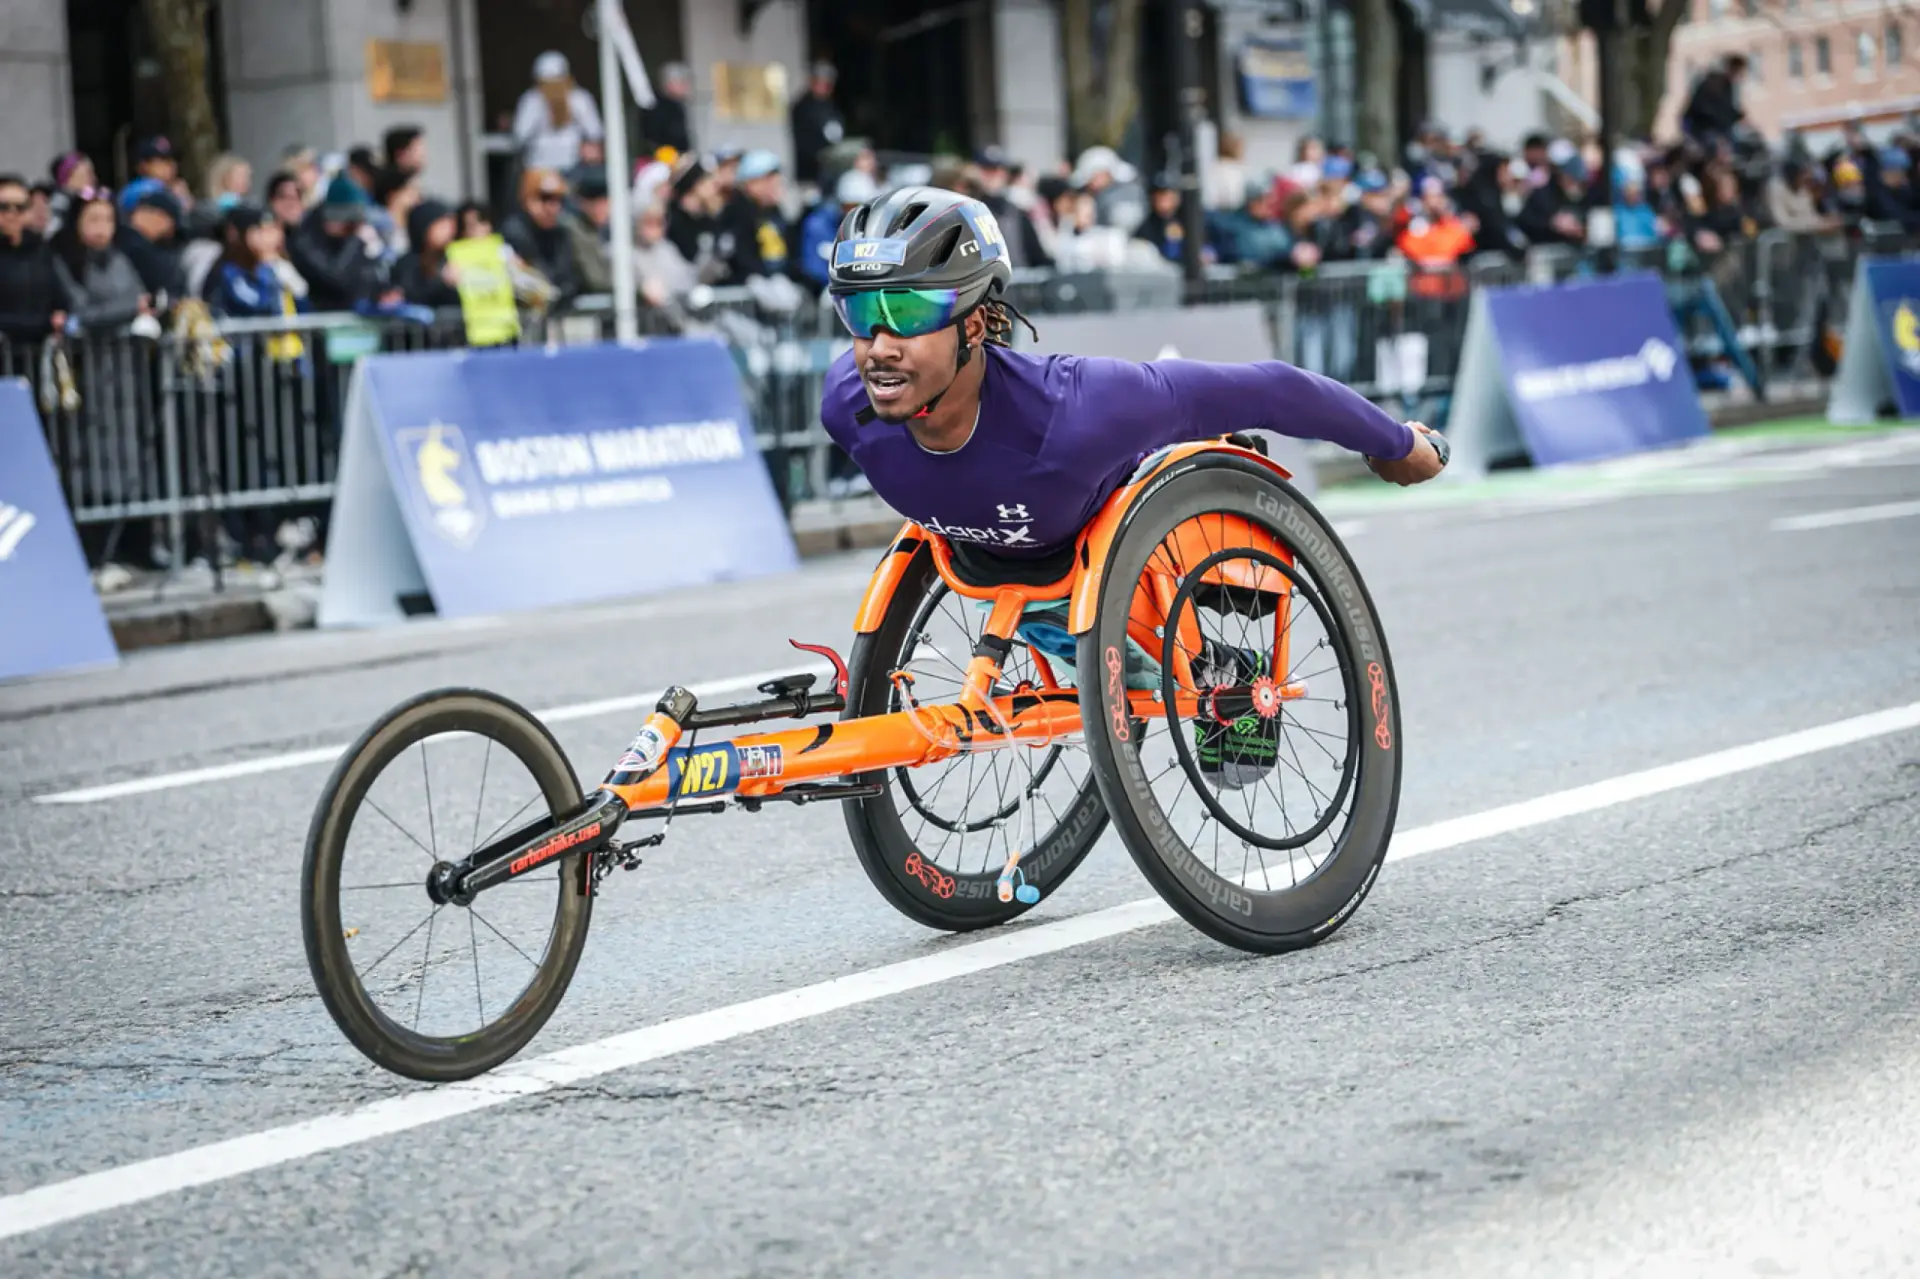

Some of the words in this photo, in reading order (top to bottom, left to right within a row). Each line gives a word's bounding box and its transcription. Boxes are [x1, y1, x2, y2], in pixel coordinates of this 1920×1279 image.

[475, 436, 593, 484] BOSTON
[591, 420, 743, 470] MARATHON
[1256, 490, 1376, 661] carbonbike.usa
[676, 750, 729, 796] W27
[510, 821, 601, 875] carbonbike.usa
[1122, 743, 1253, 917] carbonbike.usa
